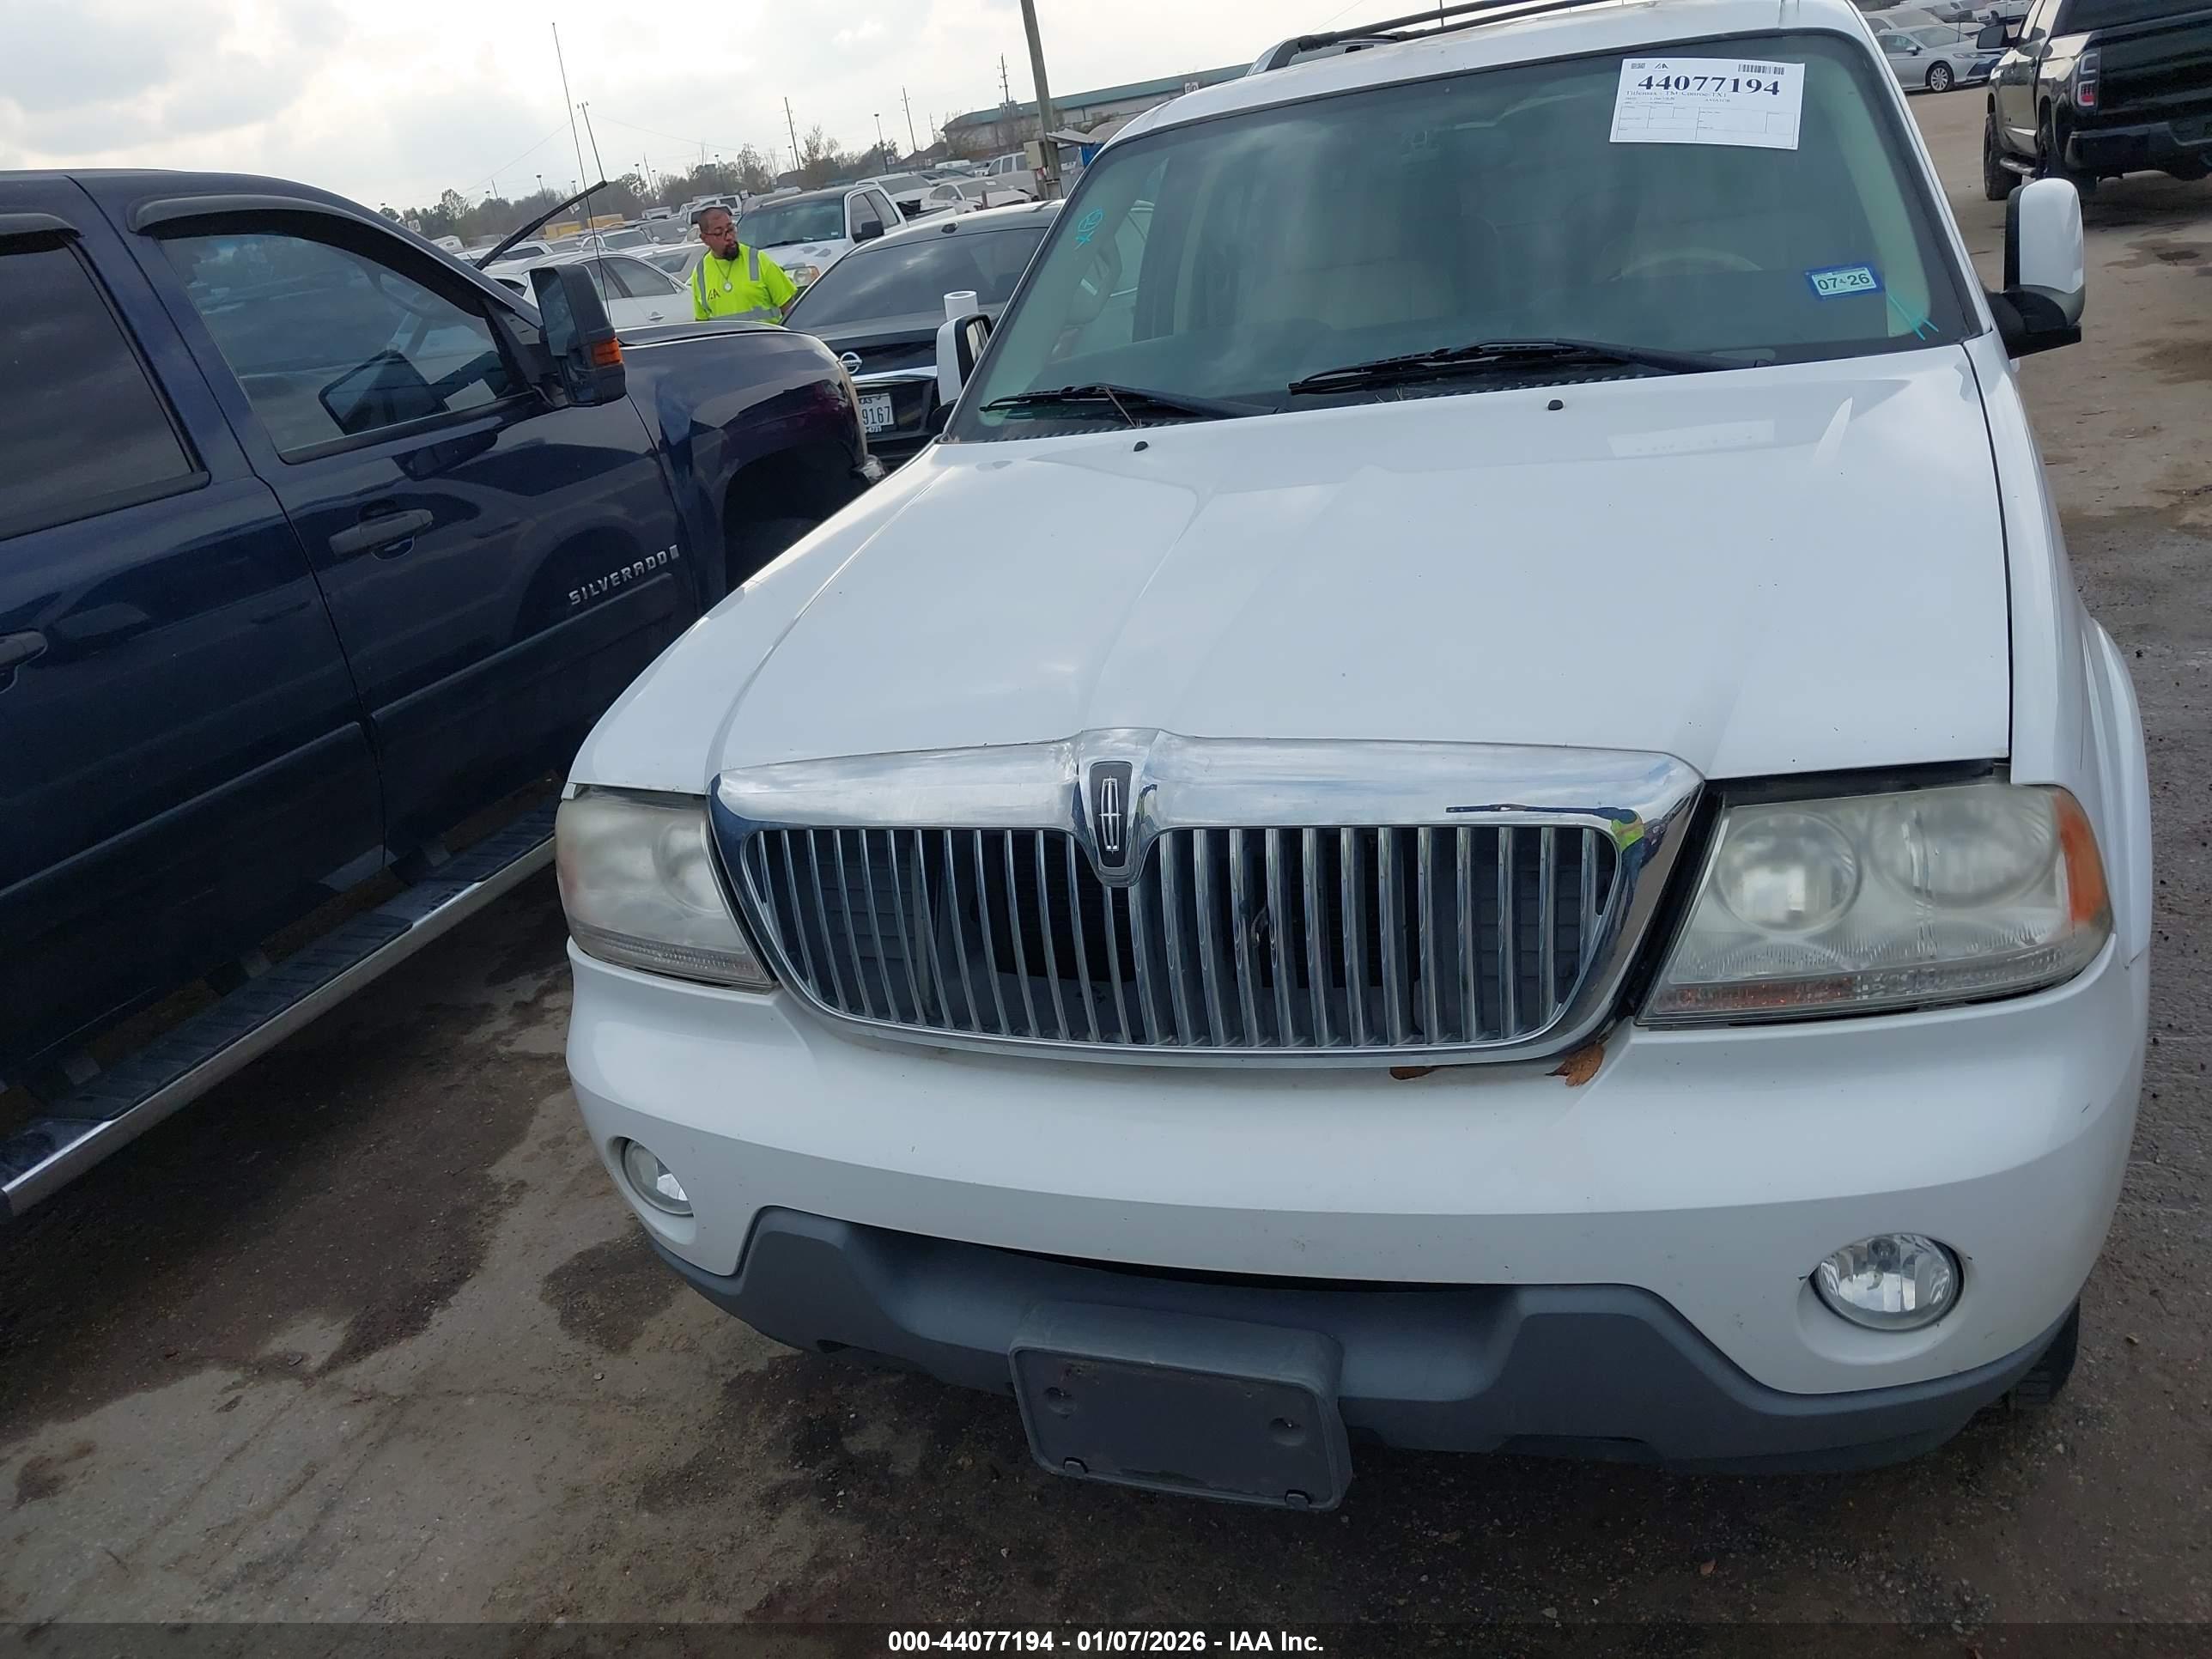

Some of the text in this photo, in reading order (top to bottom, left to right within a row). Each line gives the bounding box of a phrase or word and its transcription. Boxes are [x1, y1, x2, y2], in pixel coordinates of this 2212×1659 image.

[1638, 75, 1779, 95] 44077194
[861, 406, 890, 425] 9167
[568, 550, 667, 605] SILVERADO
